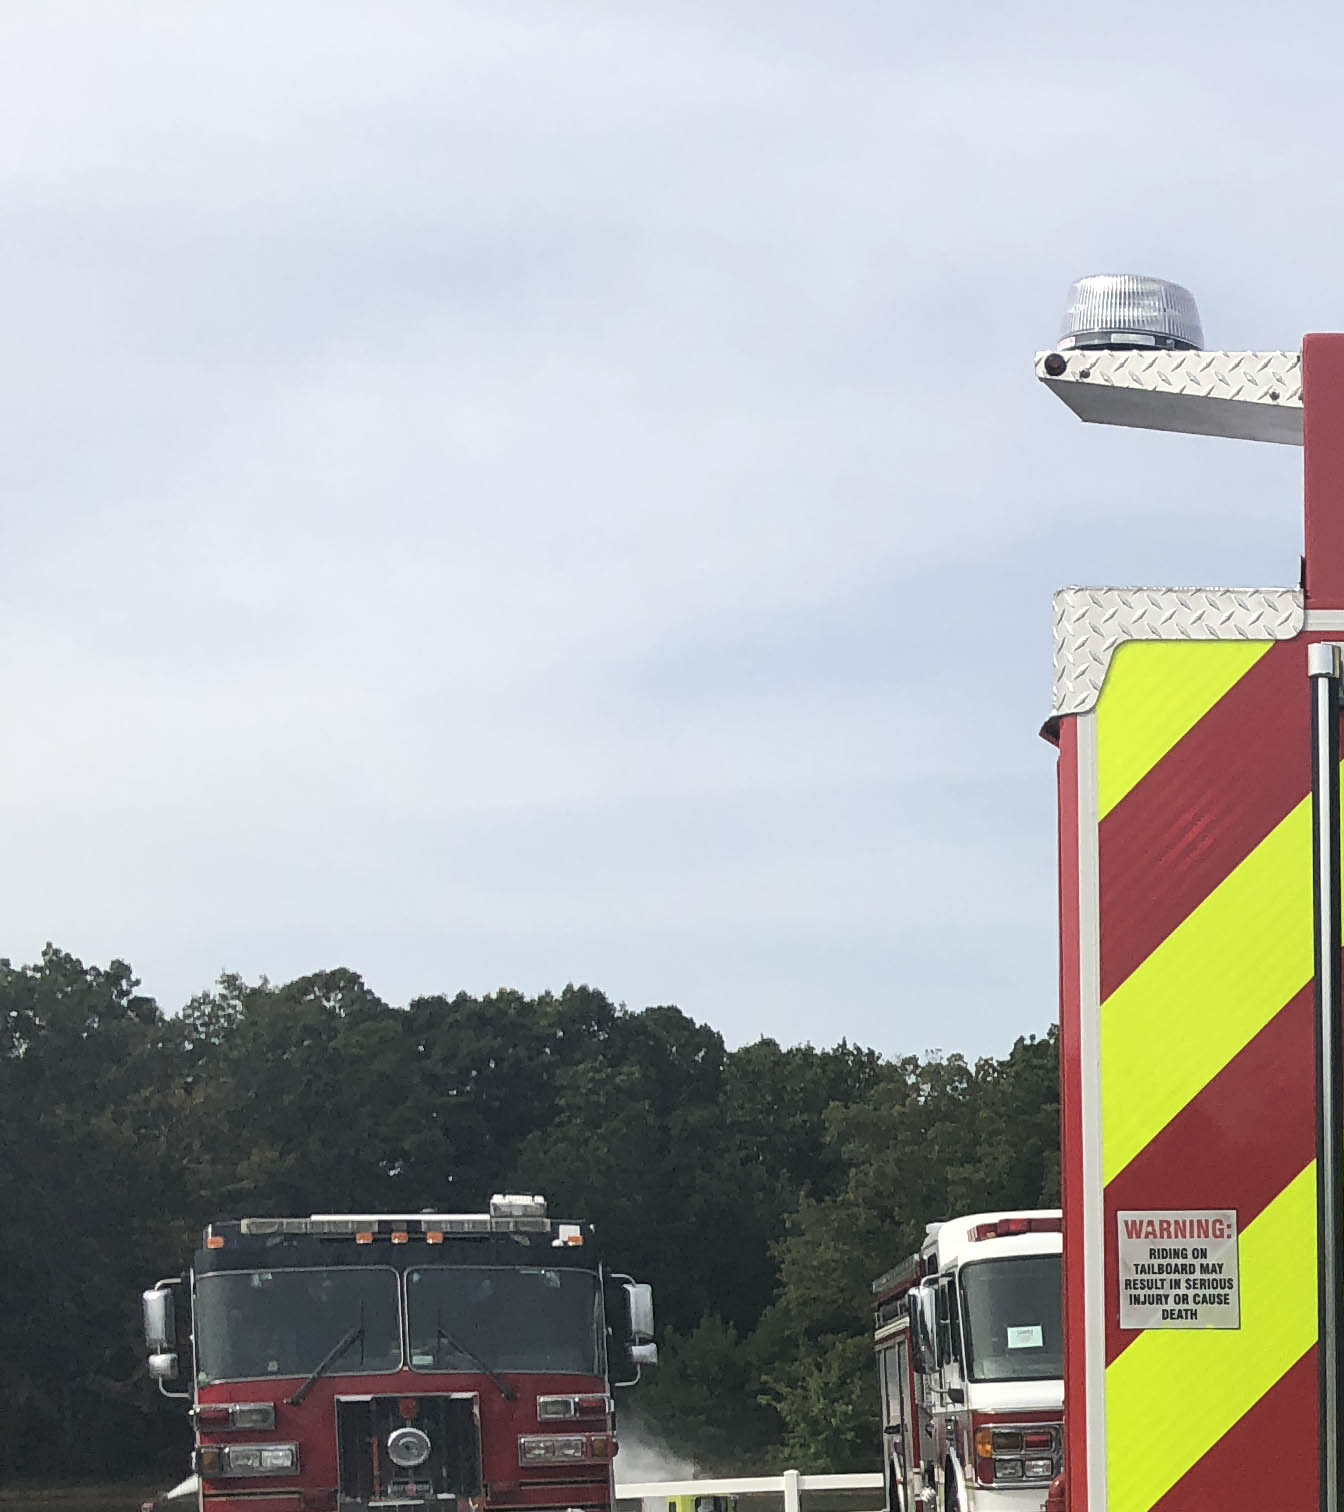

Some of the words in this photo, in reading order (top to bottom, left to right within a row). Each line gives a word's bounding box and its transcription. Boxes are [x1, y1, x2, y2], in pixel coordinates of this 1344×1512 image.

[1124, 1219, 1232, 1239] WARNING:
[1149, 1248, 1188, 1259] RIDING
[1192, 1248, 1207, 1259] ON
[1133, 1263, 1196, 1275] TAILBOARD
[1200, 1263, 1224, 1274] MAY
[1125, 1279, 1165, 1290] RESULT
[1170, 1279, 1181, 1290] IN
[1184, 1278, 1233, 1290] SERIOUS
[1129, 1294, 1169, 1305] INJURY
[1173, 1294, 1189, 1305] OR
[1193, 1293, 1230, 1305] CAUSE
[1162, 1309, 1198, 1320] DEATH
